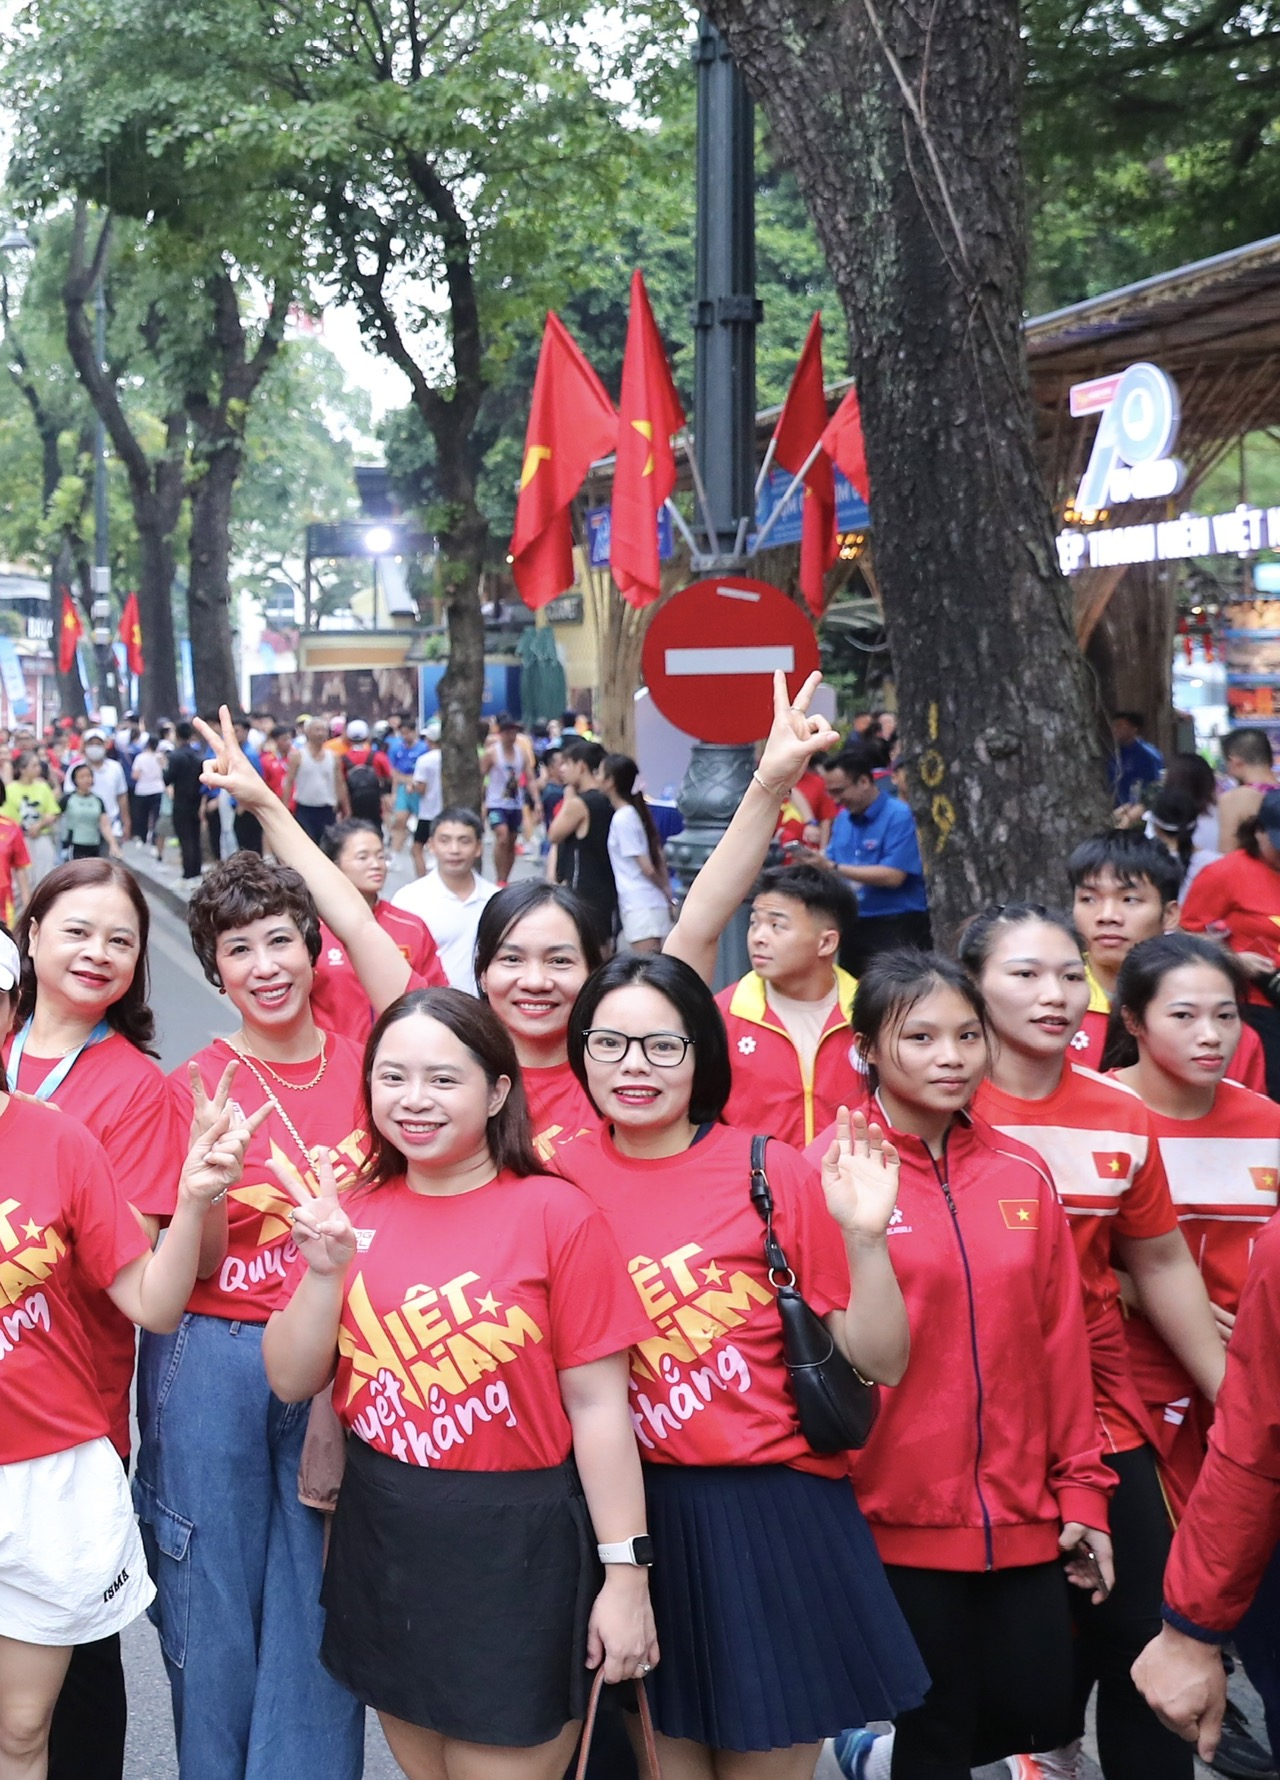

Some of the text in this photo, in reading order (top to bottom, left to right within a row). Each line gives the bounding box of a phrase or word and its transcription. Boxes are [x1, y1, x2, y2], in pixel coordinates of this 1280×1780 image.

[338, 1271, 481, 1410] VIỆT
[409, 1305, 544, 1405] NAM
[637, 1270, 774, 1379] NAM
[391, 1380, 518, 1468] thắng
